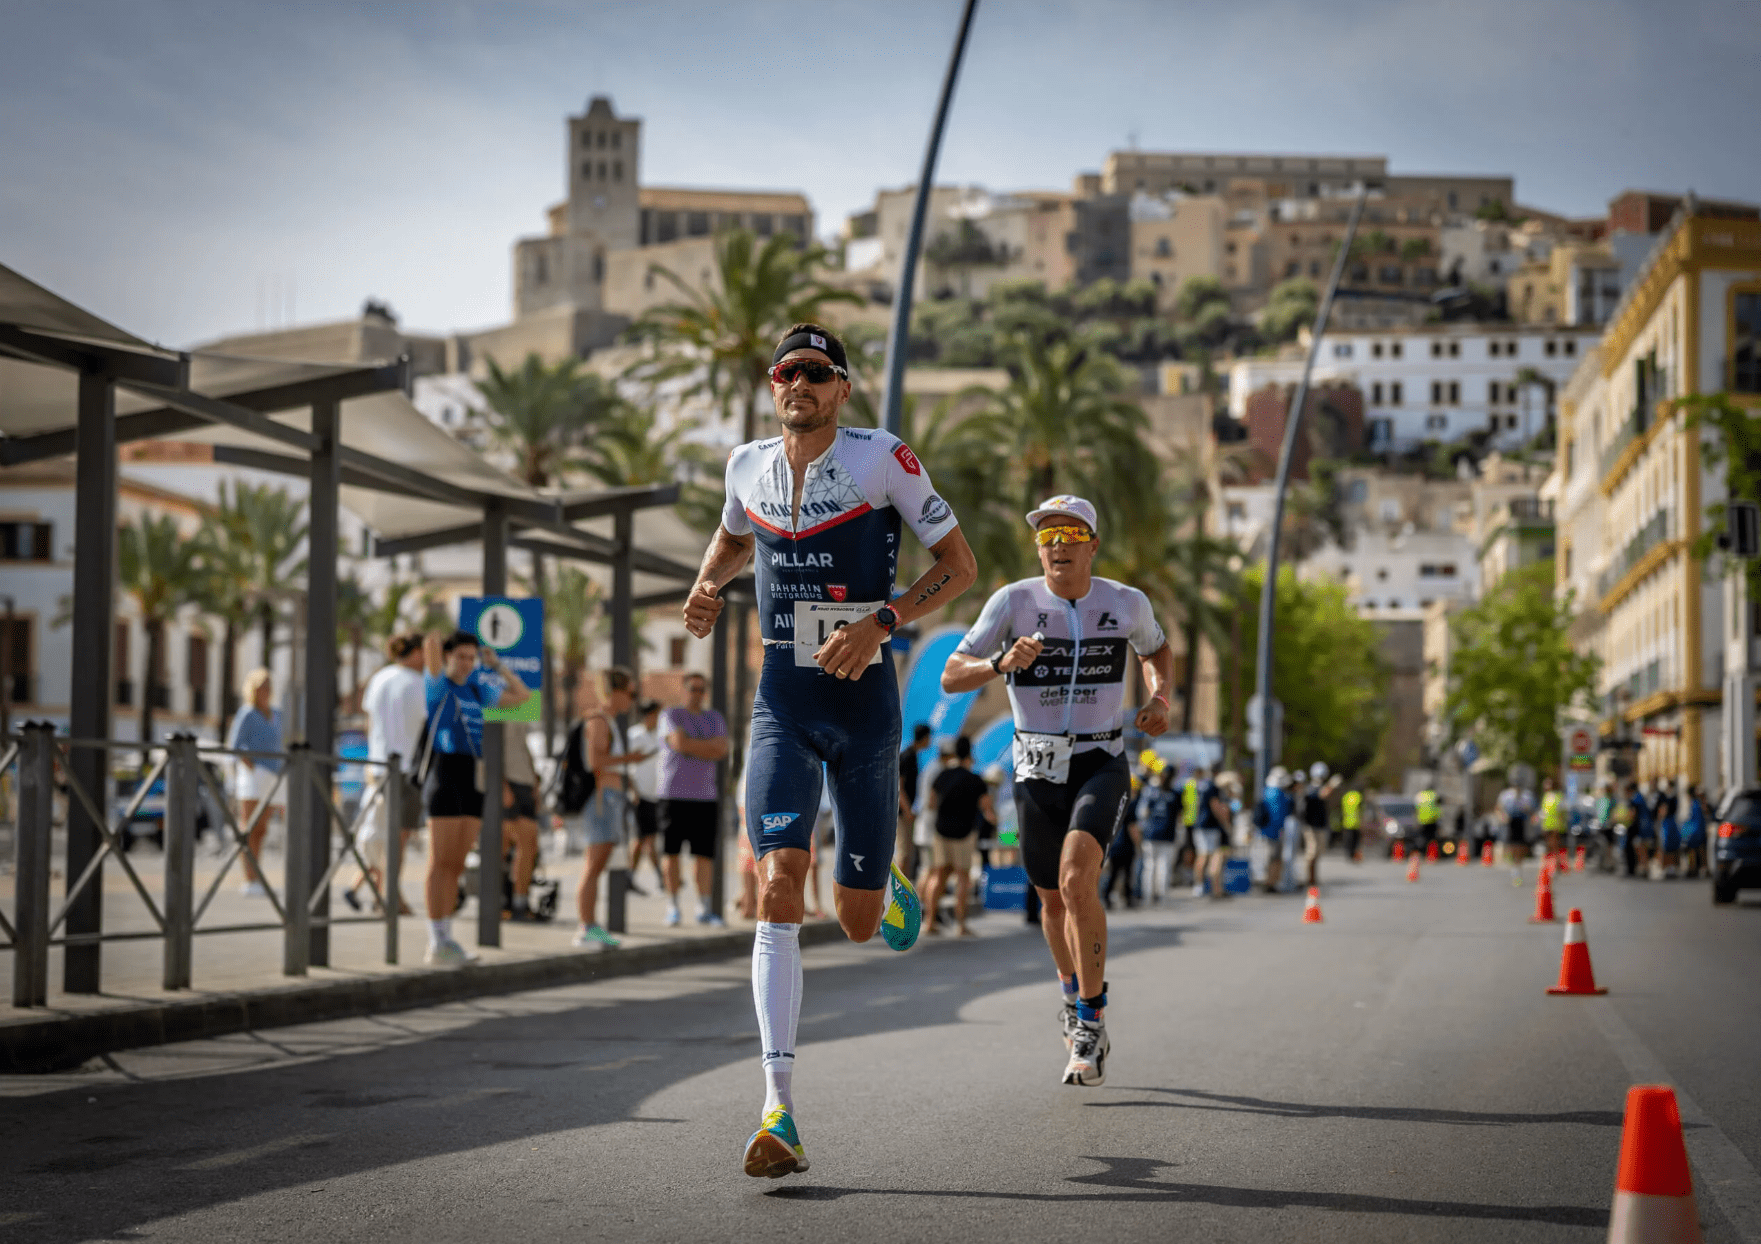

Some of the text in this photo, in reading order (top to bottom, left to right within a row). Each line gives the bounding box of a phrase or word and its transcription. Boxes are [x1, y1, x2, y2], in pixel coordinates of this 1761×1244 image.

[771, 552, 834, 567] PILLAR
[770, 583, 821, 593] BAHRAIN
[771, 592, 823, 600] VICTORIOUS
[1053, 665, 1112, 676] TEXACO
[763, 815, 792, 830] SAP
